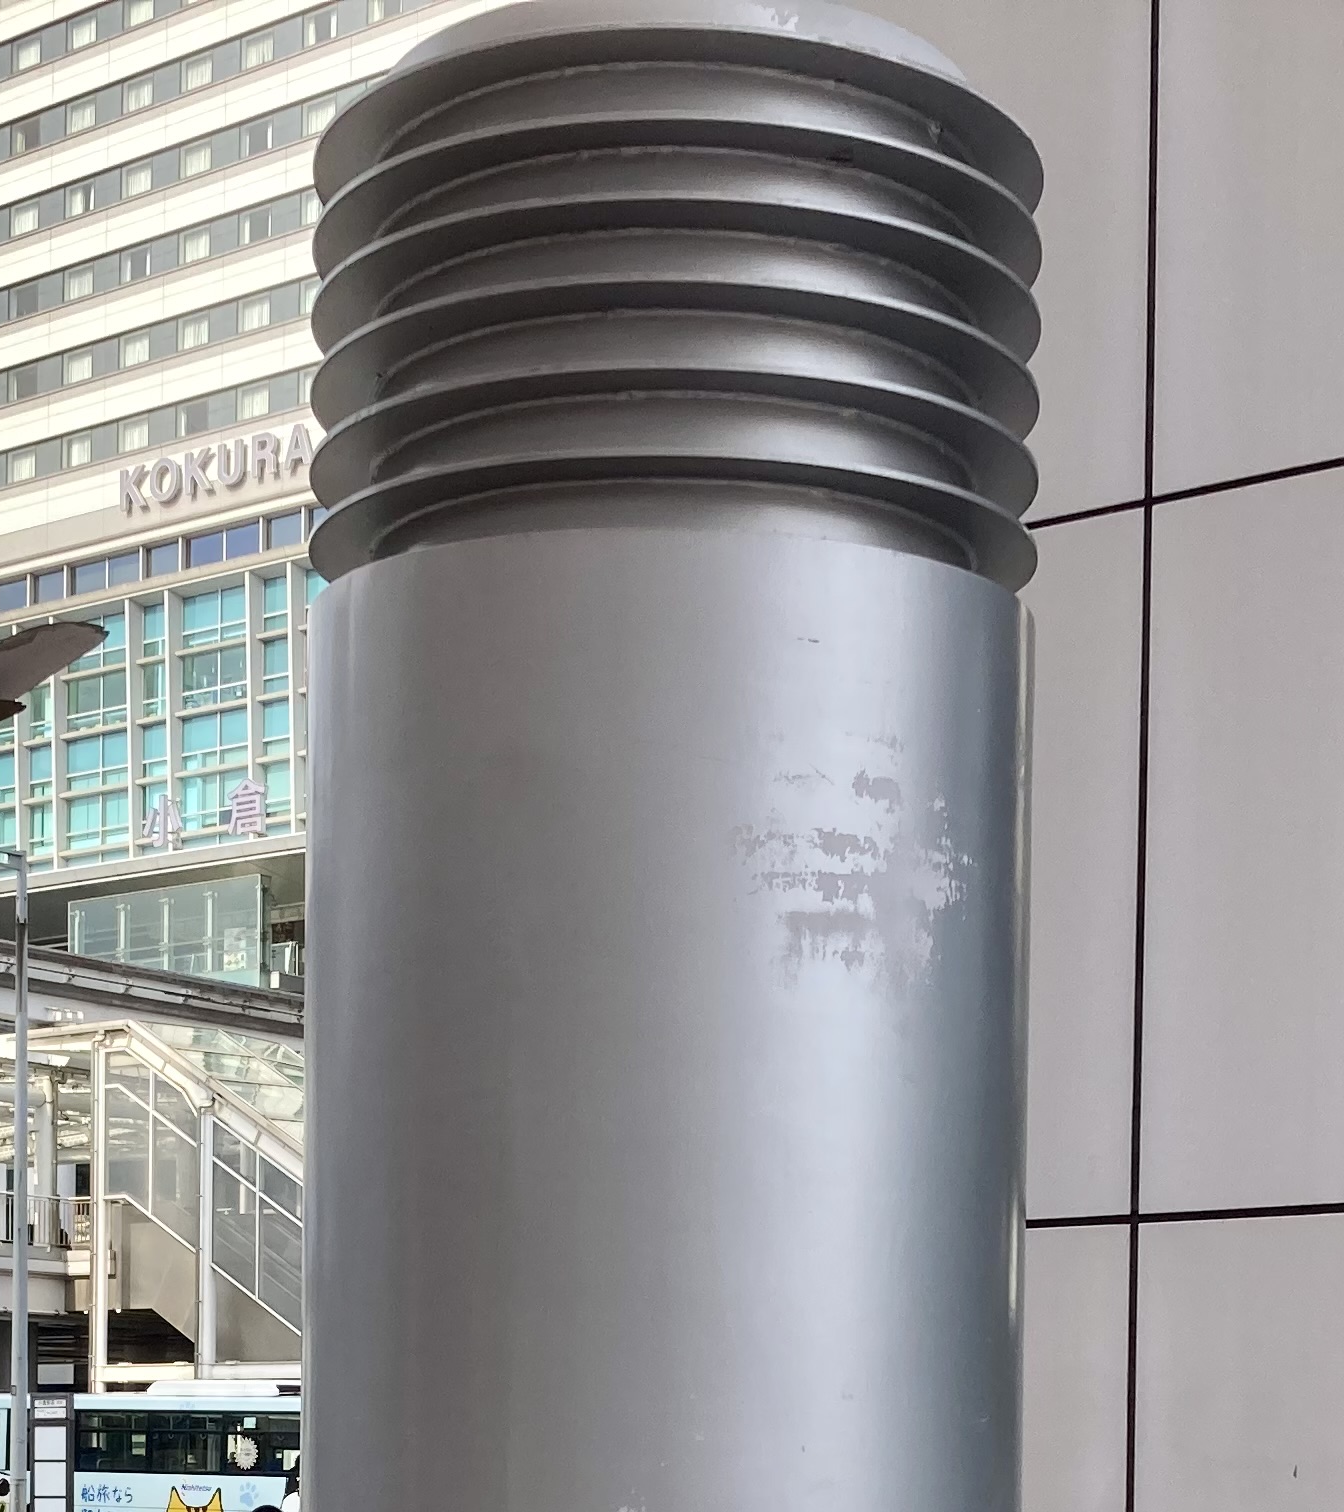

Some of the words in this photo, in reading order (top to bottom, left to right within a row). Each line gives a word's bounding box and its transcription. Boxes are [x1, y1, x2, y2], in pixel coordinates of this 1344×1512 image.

[119, 423, 313, 515] KOKURA
[143, 778, 266, 848] 小倉
[80, 1483, 134, 1504] 船旅なら
